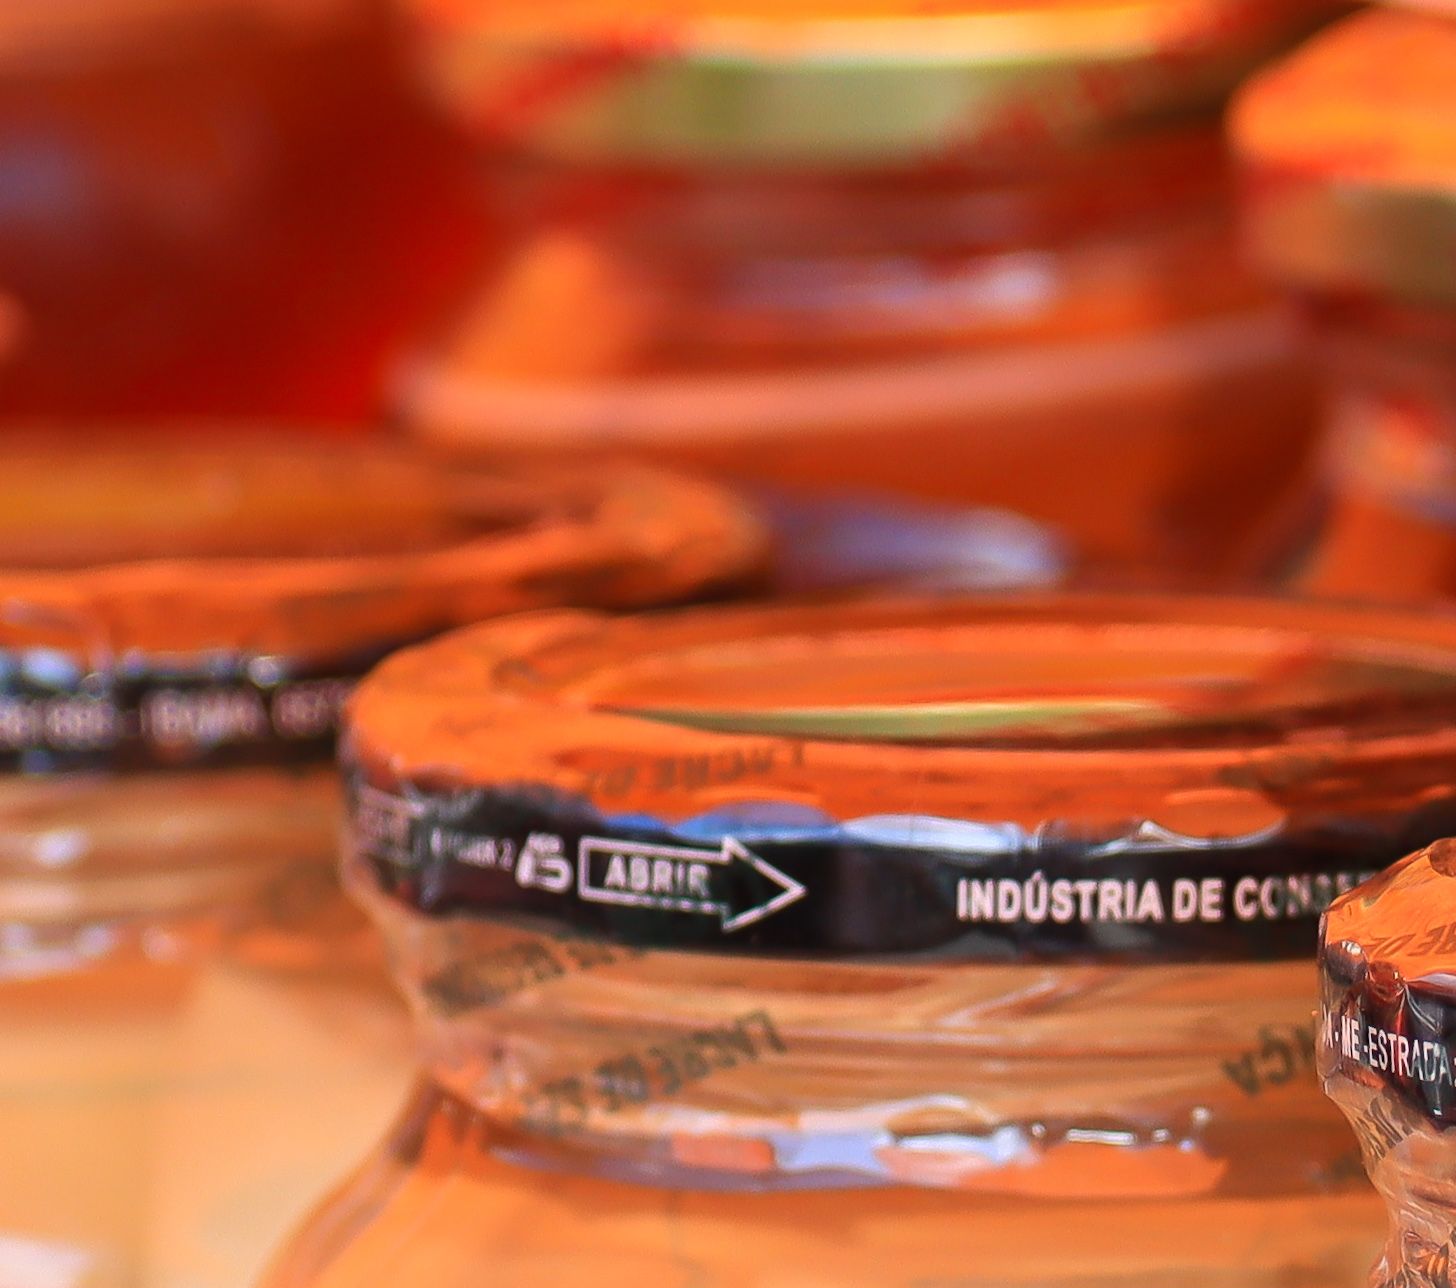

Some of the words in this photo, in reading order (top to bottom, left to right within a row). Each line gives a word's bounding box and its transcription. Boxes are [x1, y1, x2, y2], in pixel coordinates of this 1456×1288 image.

[957, 871, 1162, 924] INDÚSTRIA
[1173, 878, 1223, 921] DE
[1341, 1016, 1360, 1061] ME
